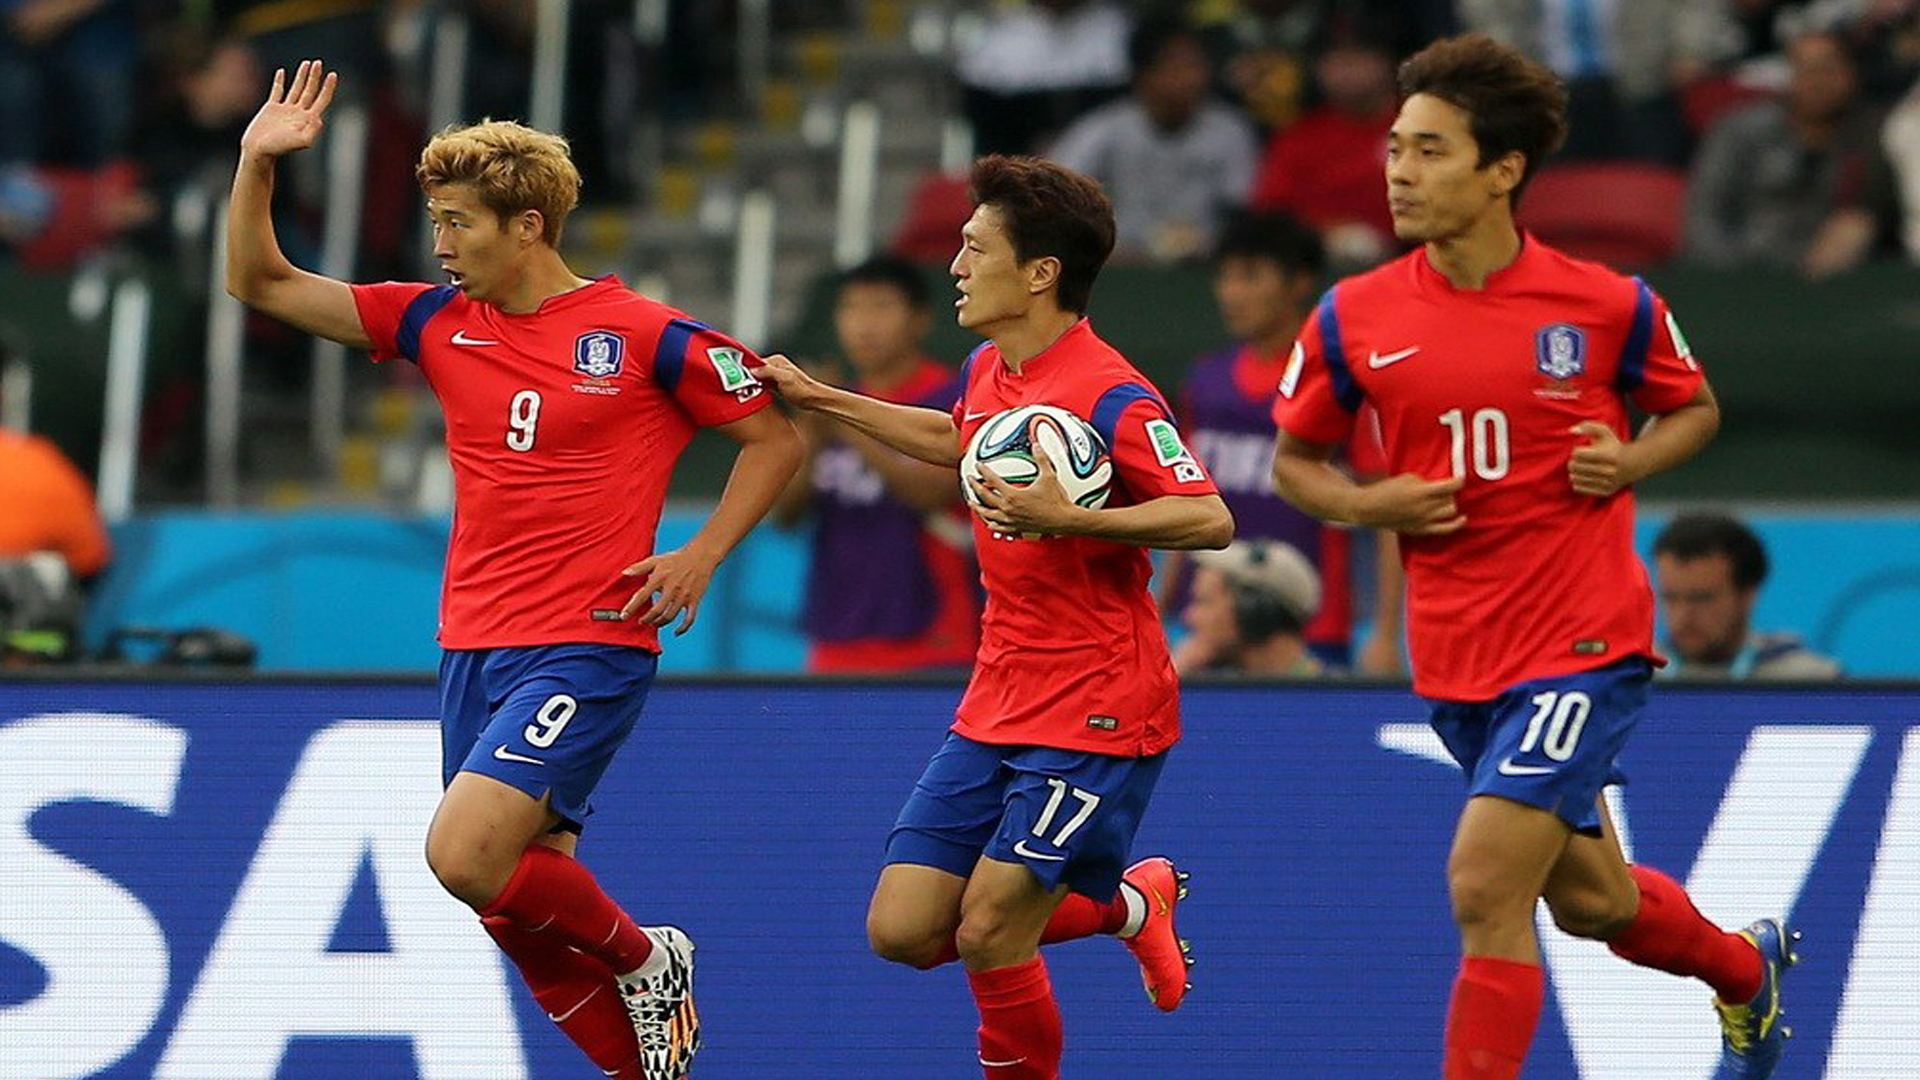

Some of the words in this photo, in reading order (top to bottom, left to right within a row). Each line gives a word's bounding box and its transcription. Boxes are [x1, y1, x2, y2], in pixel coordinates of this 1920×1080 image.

[506, 390, 541, 452] 9
[1438, 407, 1511, 481] 10
[524, 693, 577, 748] 9
[1518, 690, 1592, 762] 10
[1031, 778, 1101, 848] 17
